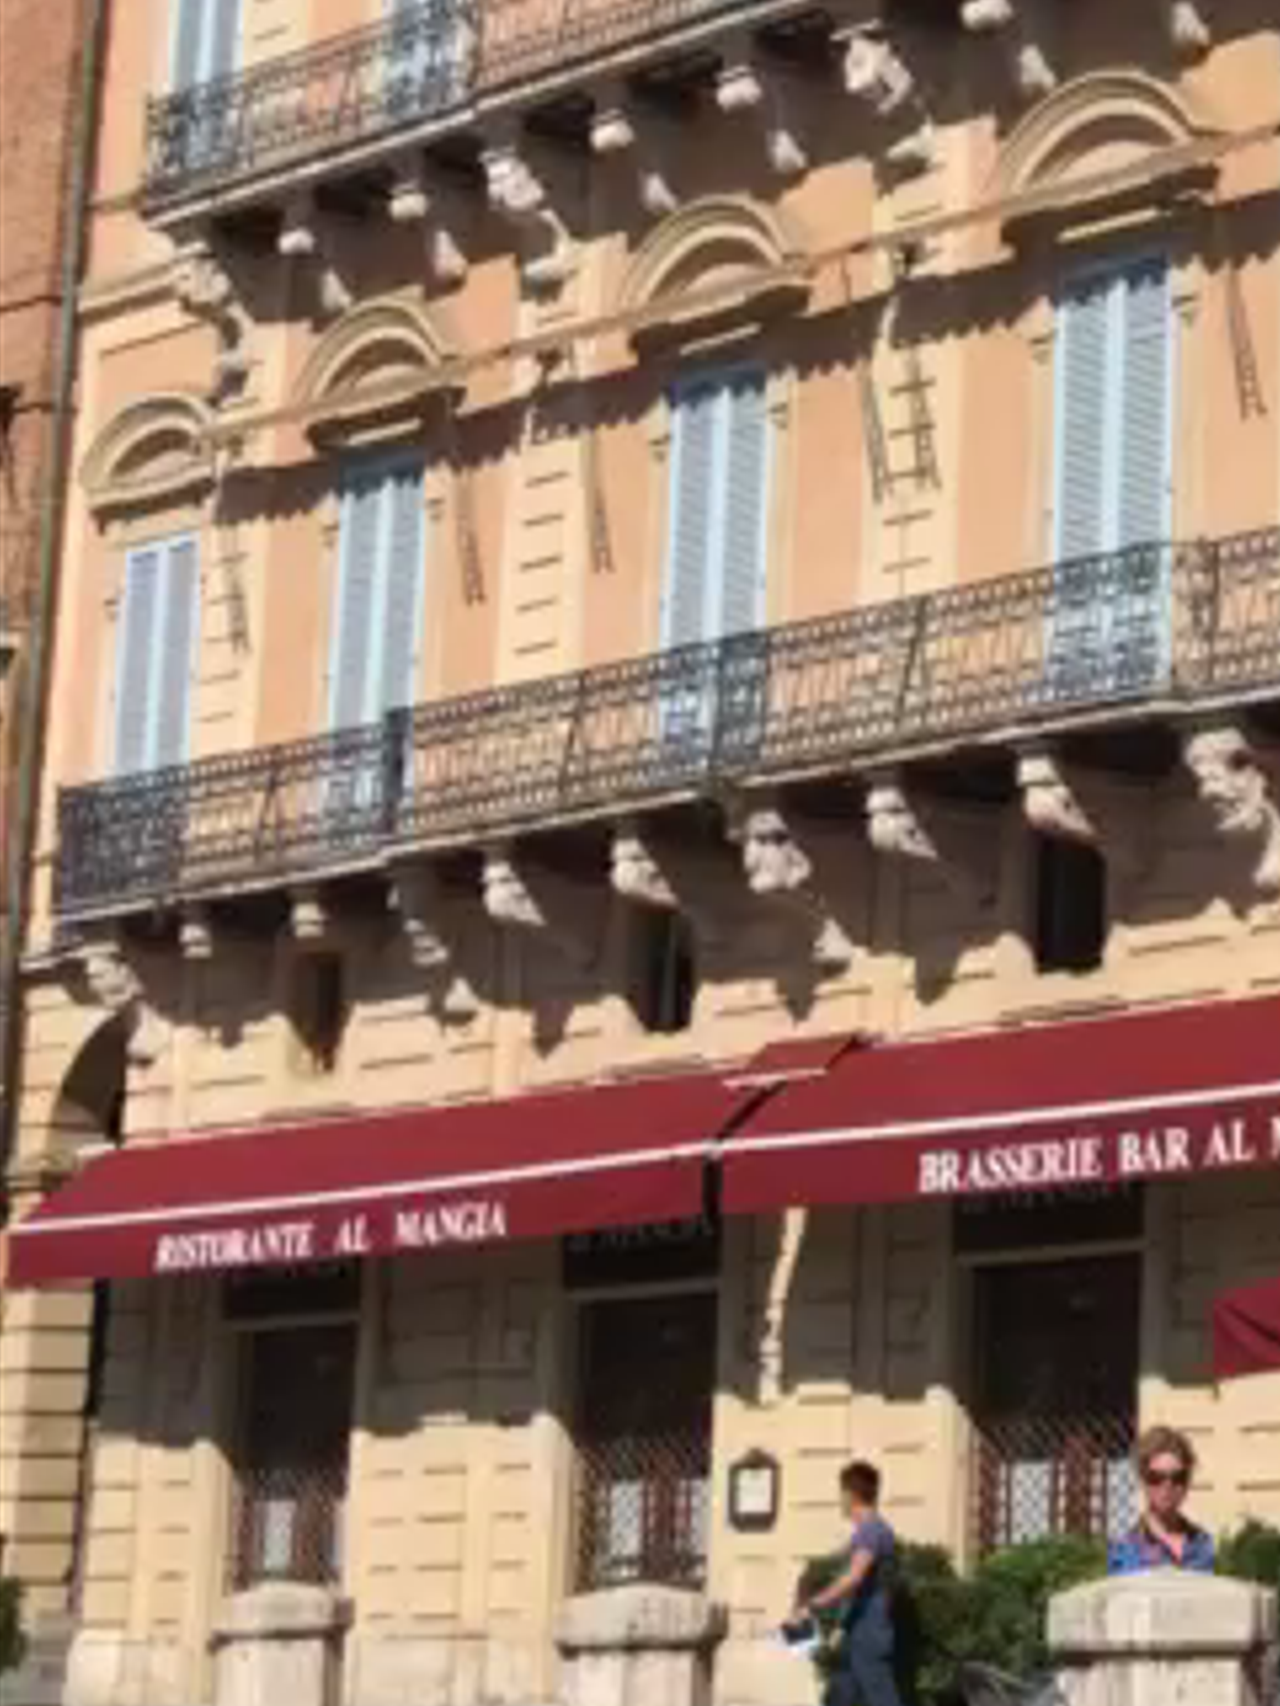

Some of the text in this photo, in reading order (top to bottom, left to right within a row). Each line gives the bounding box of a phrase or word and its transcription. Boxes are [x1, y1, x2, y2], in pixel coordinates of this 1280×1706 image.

[918, 1137, 1102, 1194] BRASSERIE
[1117, 1127, 1191, 1174] BAR
[1203, 1119, 1256, 1164] AL
[155, 1201, 507, 1272] RISTORANTE AL MANGIA
